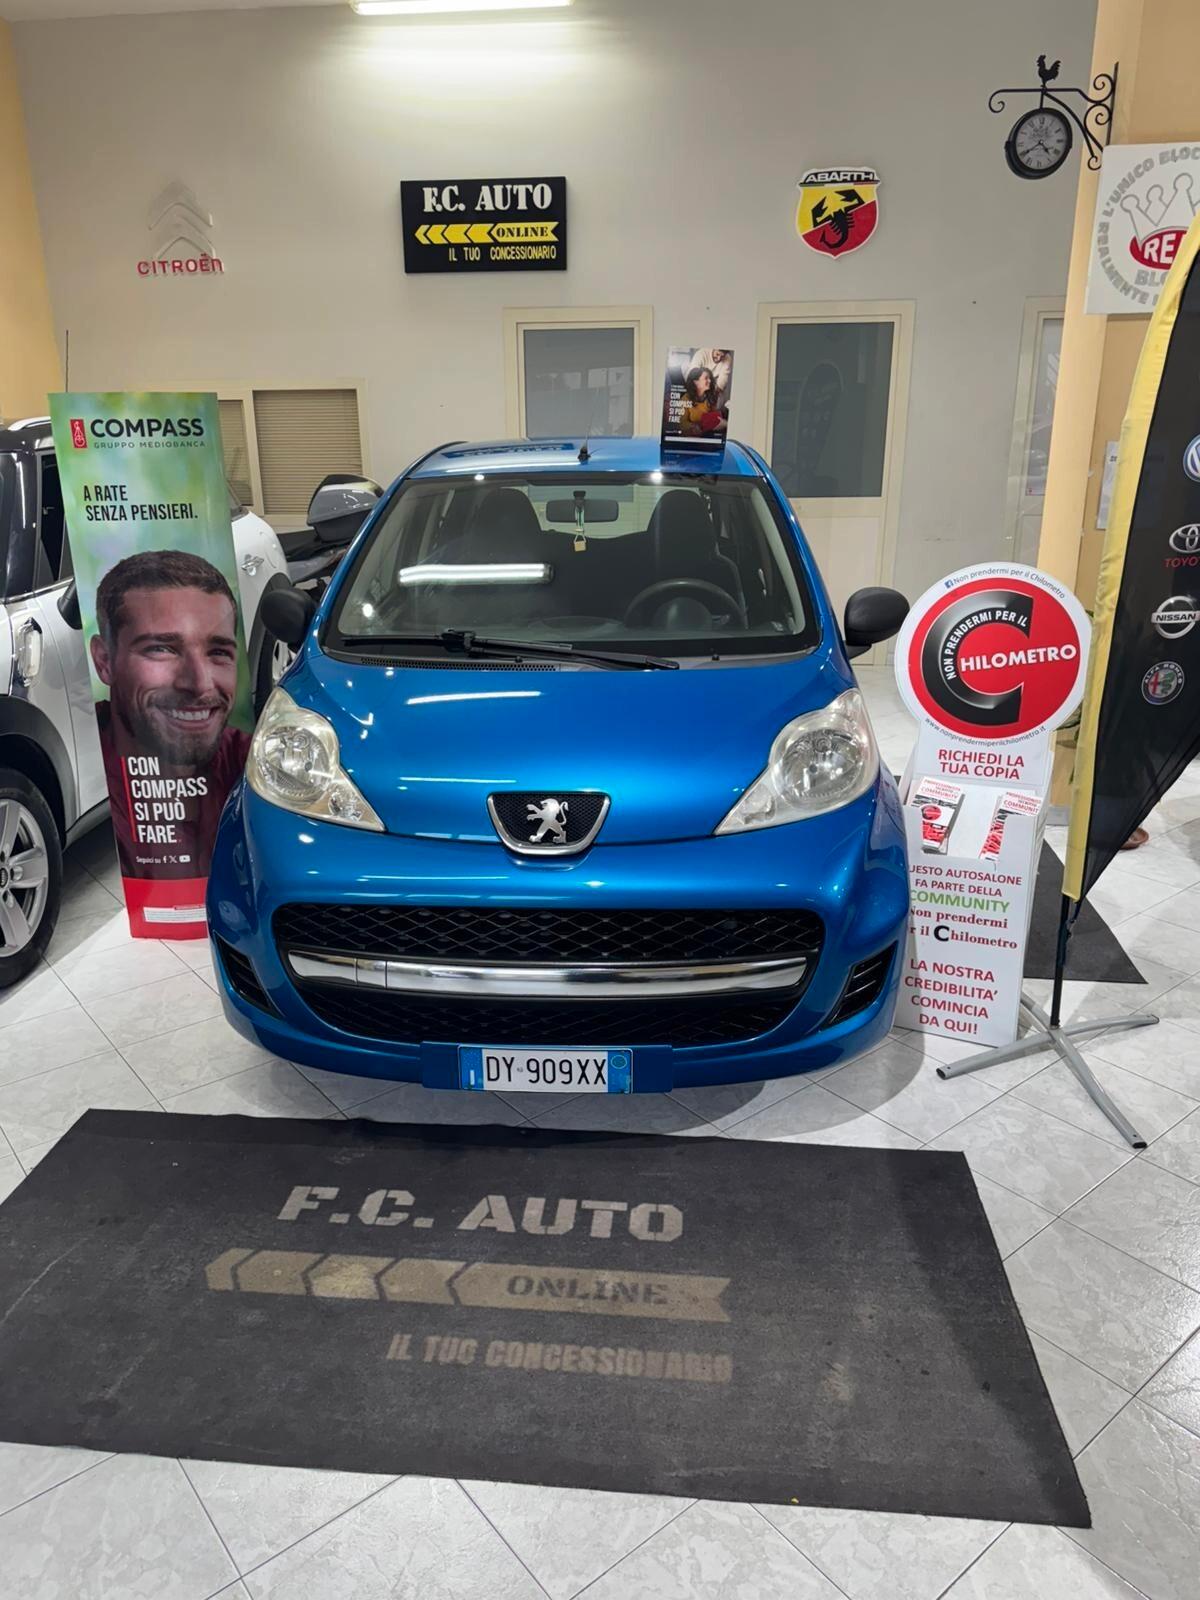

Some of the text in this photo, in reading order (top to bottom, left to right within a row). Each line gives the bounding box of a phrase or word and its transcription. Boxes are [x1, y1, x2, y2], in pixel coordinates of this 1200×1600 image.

[805, 172, 873, 183] ABARTH
[423, 183, 553, 213] F.C. AUTO
[496, 226, 549, 238] ONLINE
[449, 245, 557, 262] IL TUO CONCESSIONARIO
[669, 400, 693, 408] COMPASS
[90, 418, 205, 438] COMPASS
[94, 440, 205, 449] GRUPPO MEDIOBANCA
[83, 485, 128, 501] A RATE
[85, 503, 198, 521] SENZA PENSIERI.
[953, 568, 1066, 599] Non prendermi per il Chilometro
[1155, 613, 1197, 622] NISSAN
[943, 610, 1028, 681] NON PRENDERMI PER IL
[1144, 663, 1183, 684] ALFA ROMEO
[127, 756, 160, 776] CON
[938, 749, 1024, 767] RICHIEDI LA
[940, 761, 1020, 780] TUA COPIA
[131, 776, 208, 799] COMPASS
[134, 797, 186, 821] SI PUÒ
[945, 869, 1022, 885] AUTOSALONE
[915, 879, 1002, 897] FA PARTE DELLA
[911, 890, 1010, 913] COMMUNITY
[936, 911, 1008, 929] prendermi
[920, 926, 930, 936] il
[933, 925, 1018, 949] Chilometro
[910, 959, 995, 983] LA NOSTRA
[911, 995, 989, 1018] COMINCIA
[919, 1014, 978, 1035] DA QUI!
[486, 1056, 607, 1085] DY 909XX
[277, 1185, 683, 1242] F.C. AUTO
[506, 1275, 669, 1305] ONLINE
[387, 1334, 412, 1361] IL
[485, 1340, 734, 1384] CONCESSIONARIO
